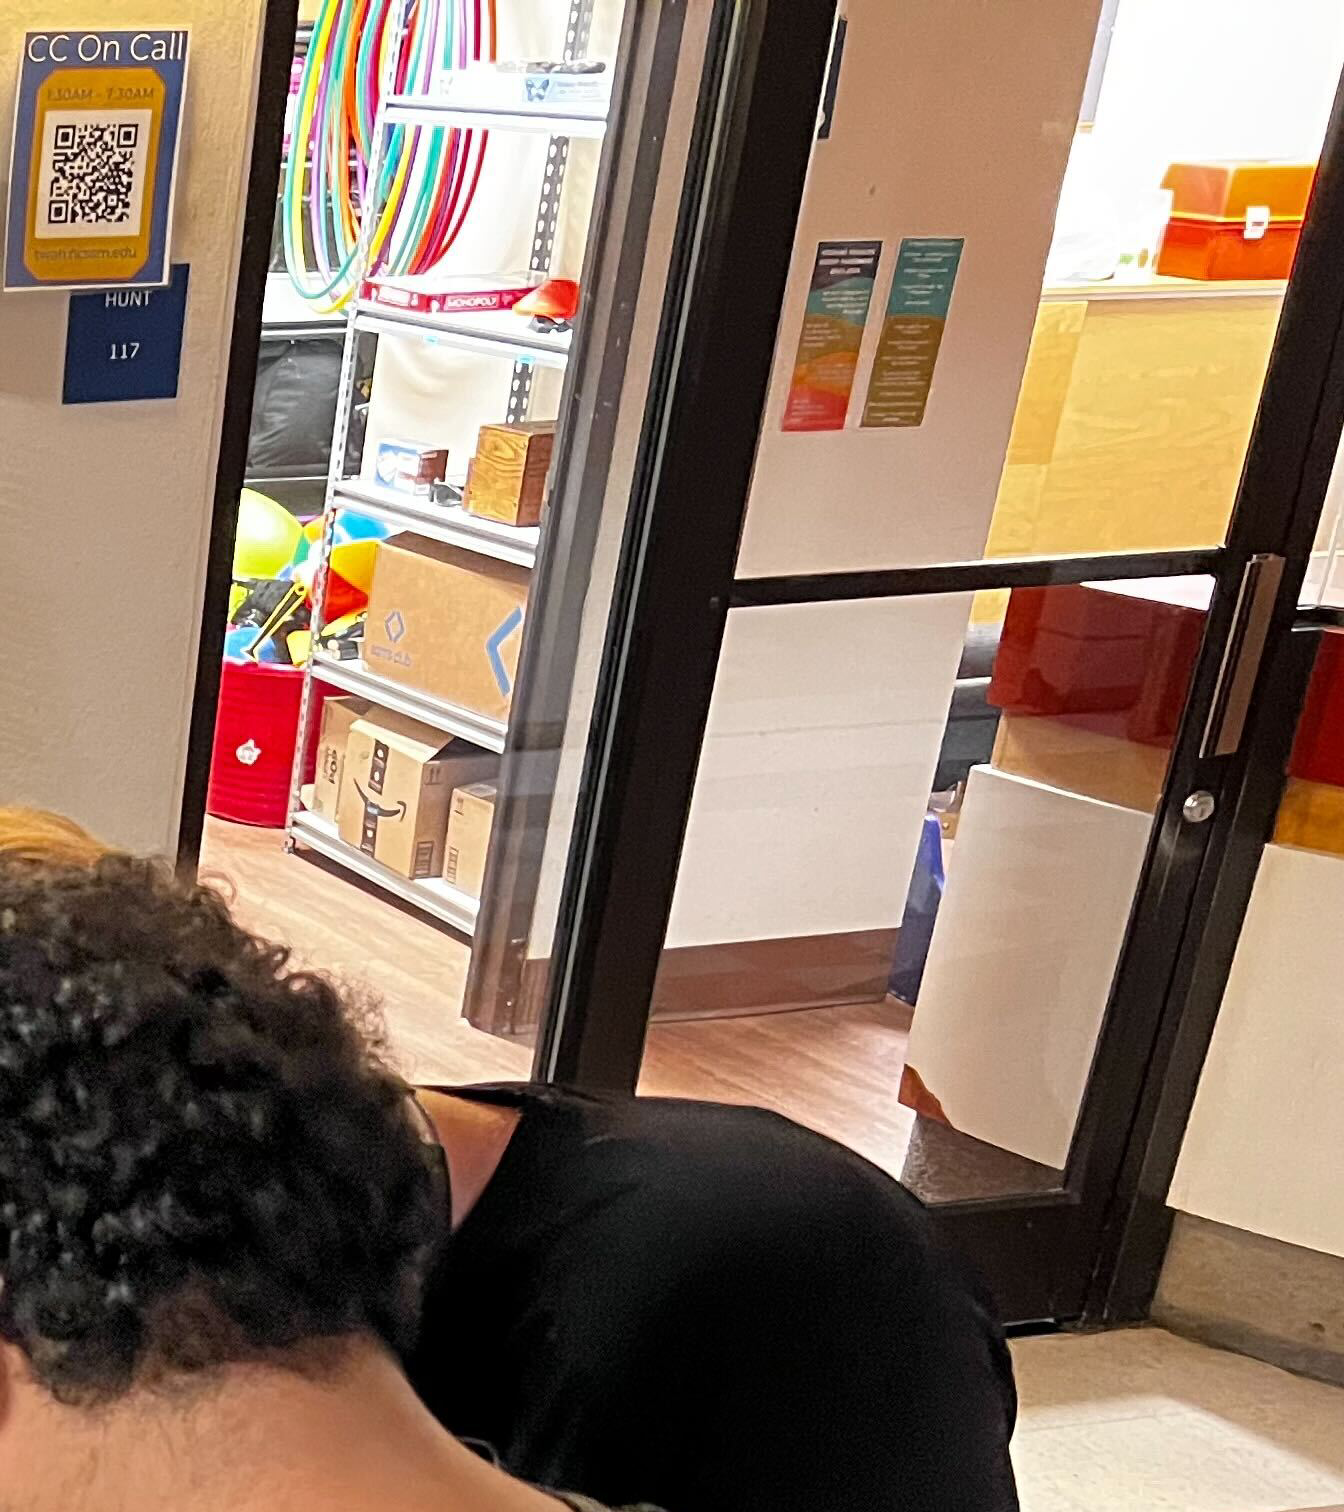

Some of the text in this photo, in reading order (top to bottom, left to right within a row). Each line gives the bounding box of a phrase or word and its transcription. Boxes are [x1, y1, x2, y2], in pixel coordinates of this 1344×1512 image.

[27, 32, 183, 62] CC On Call
[105, 290, 152, 308] HUNT
[109, 342, 140, 360] 117
